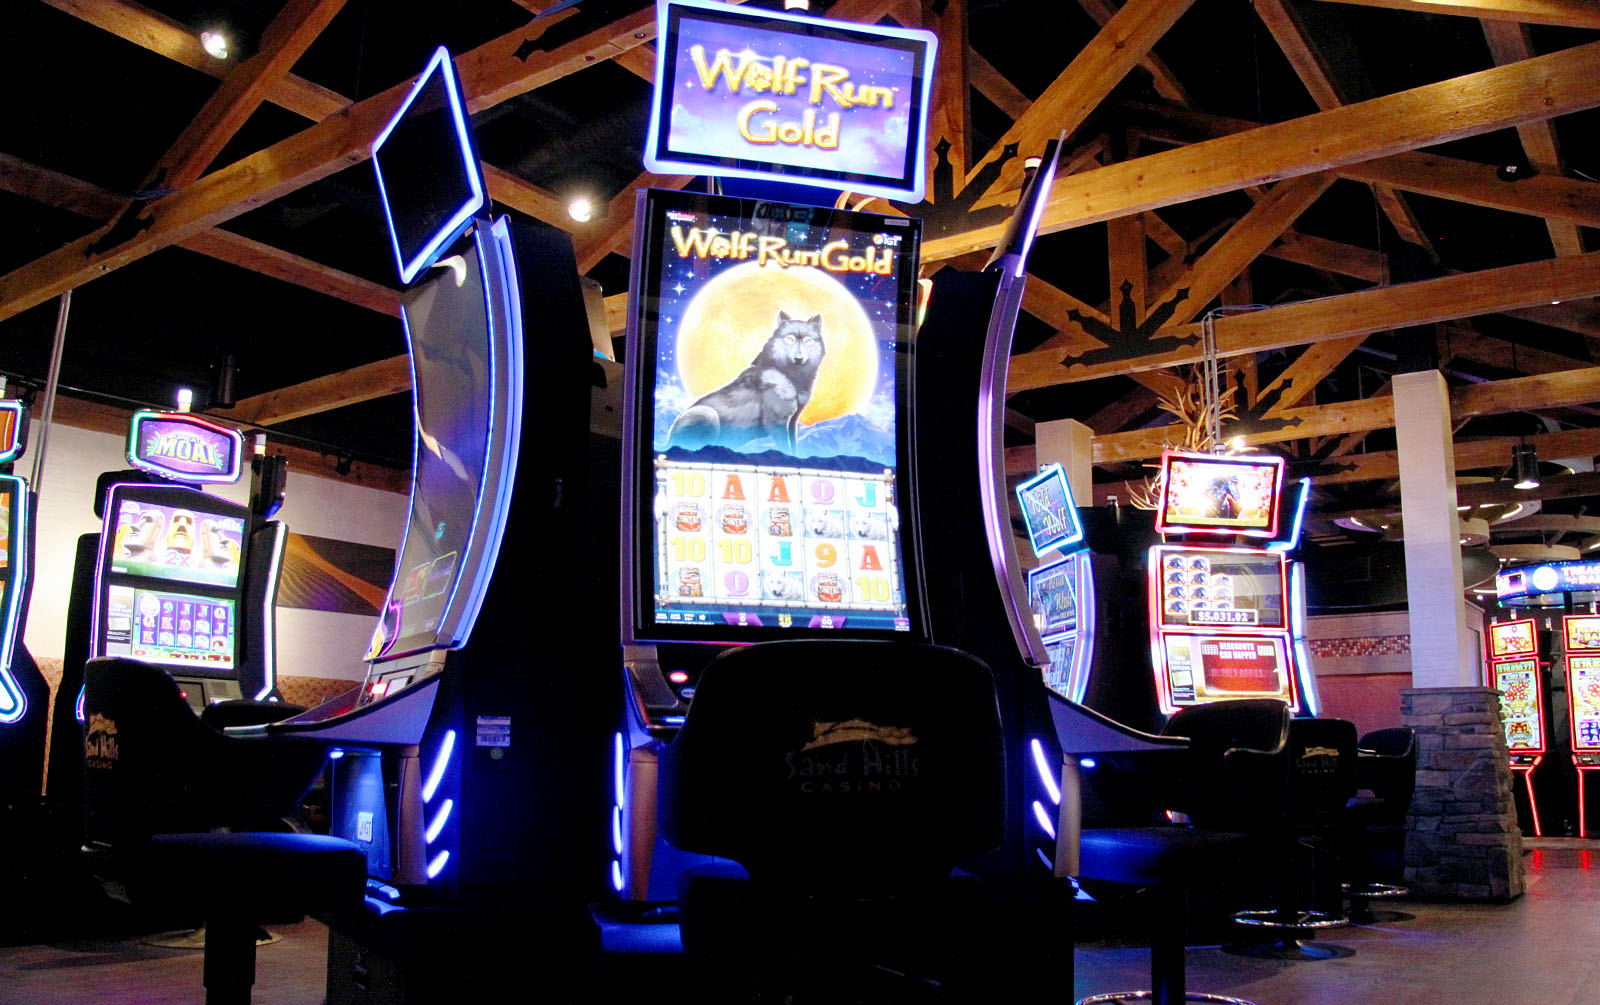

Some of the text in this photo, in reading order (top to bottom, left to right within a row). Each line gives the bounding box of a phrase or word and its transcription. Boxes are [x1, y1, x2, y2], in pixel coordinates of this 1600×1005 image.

[738, 100, 840, 151] Gold
[154, 437, 216, 465] MOAI
[670, 471, 705, 497] 10
[722, 473, 746, 500] A
[767, 476, 791, 503] A
[855, 482, 877, 508] J
[670, 536, 883, 571] 10 10 J 9 A
[855, 576, 890, 602] 10
